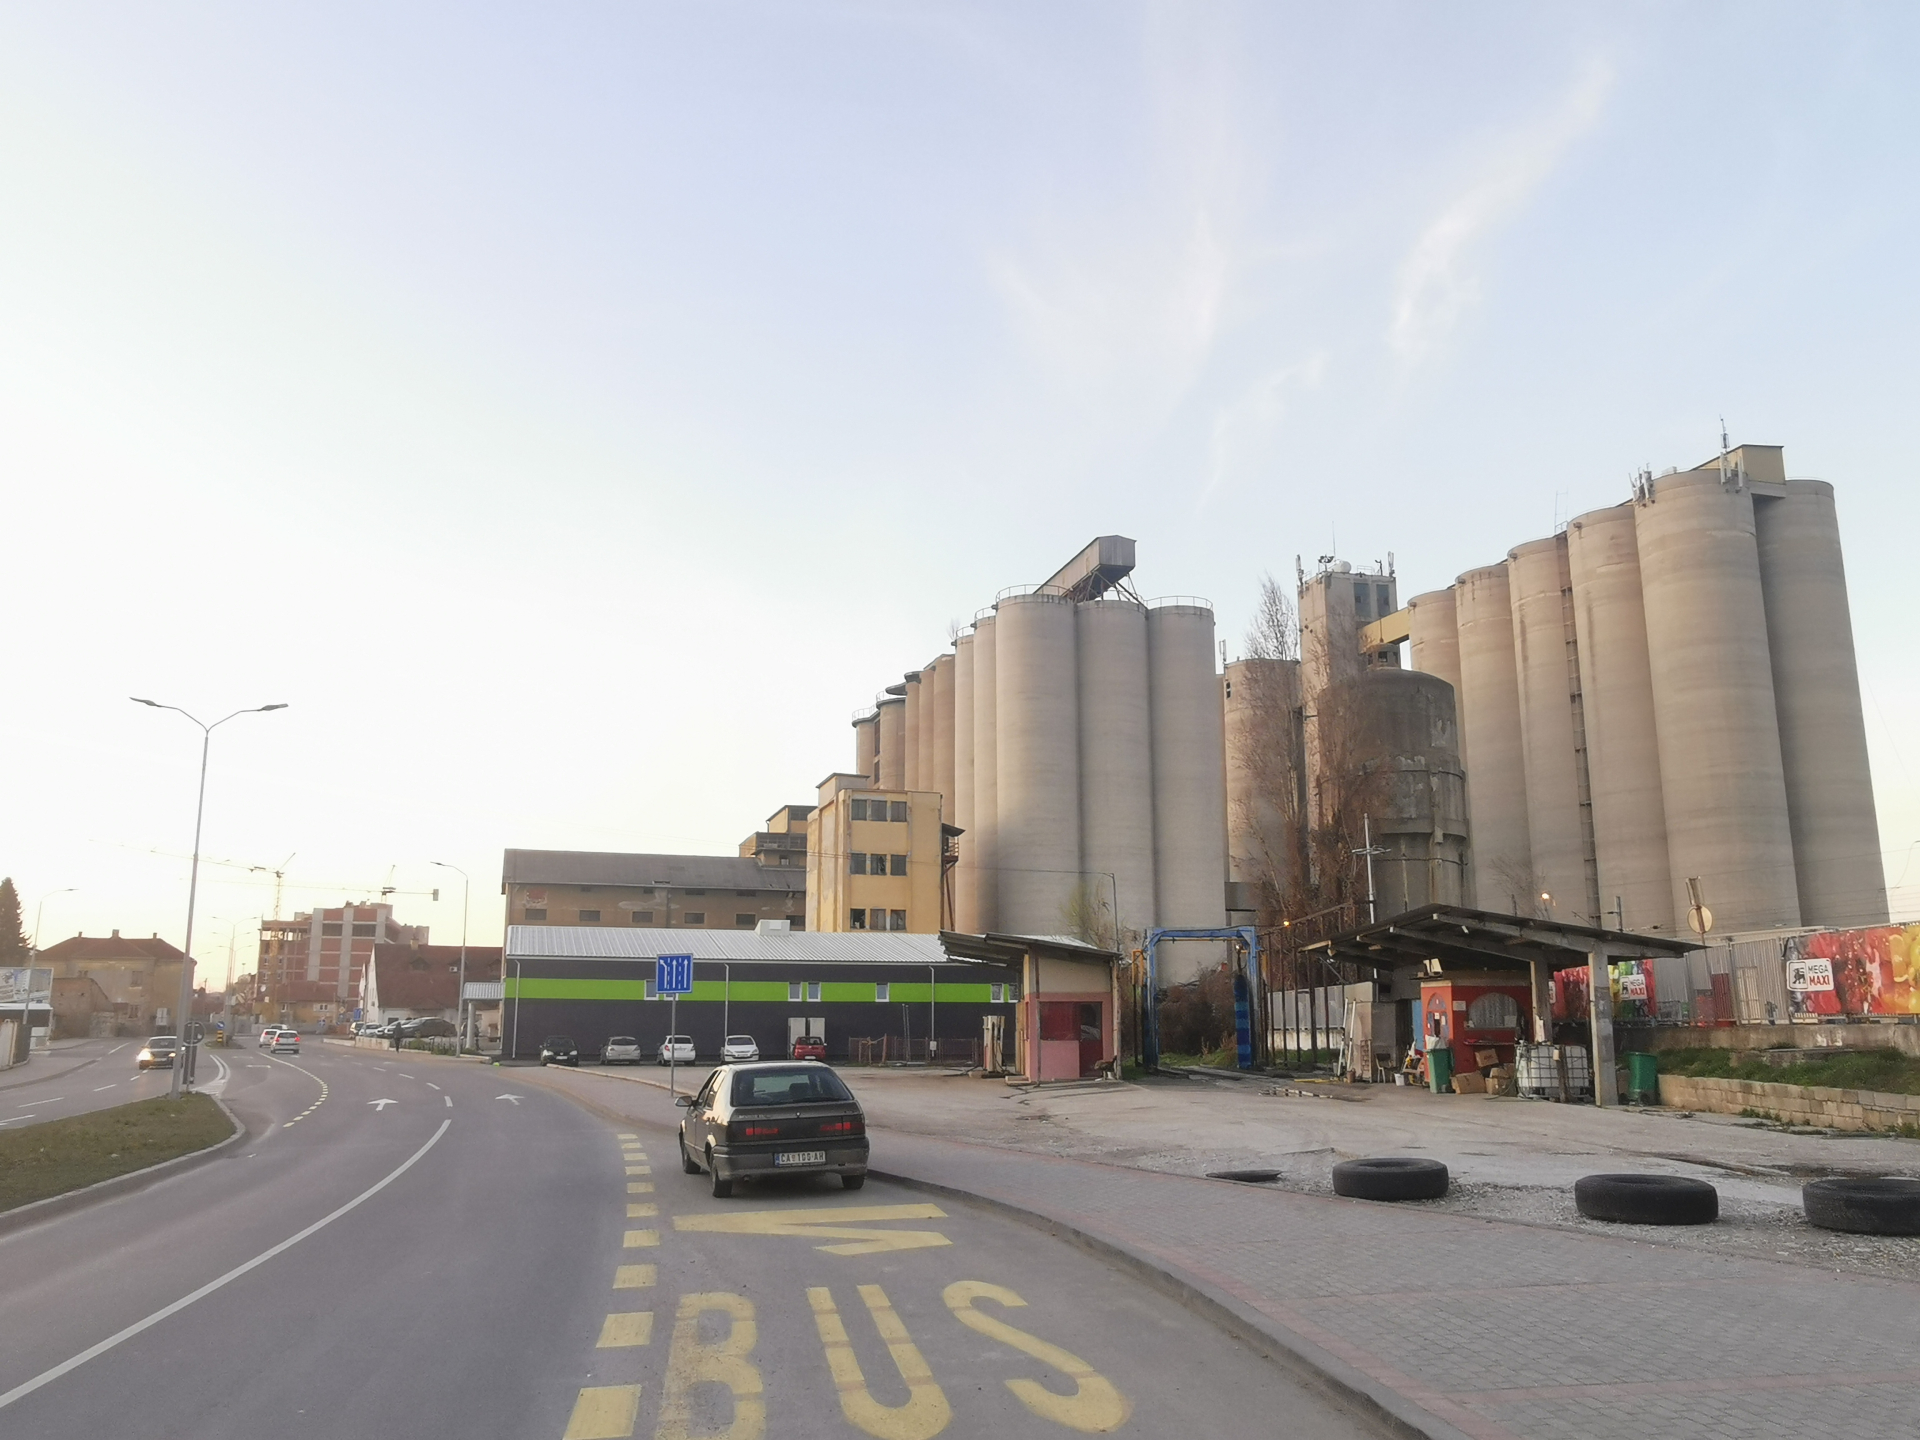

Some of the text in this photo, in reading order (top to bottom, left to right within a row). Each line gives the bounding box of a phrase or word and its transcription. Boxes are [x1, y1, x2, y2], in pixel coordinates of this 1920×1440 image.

[1808, 965, 1829, 974] MEGA
[1809, 975, 1830, 986] MAXI
[656, 1279, 1134, 1440] BUS
